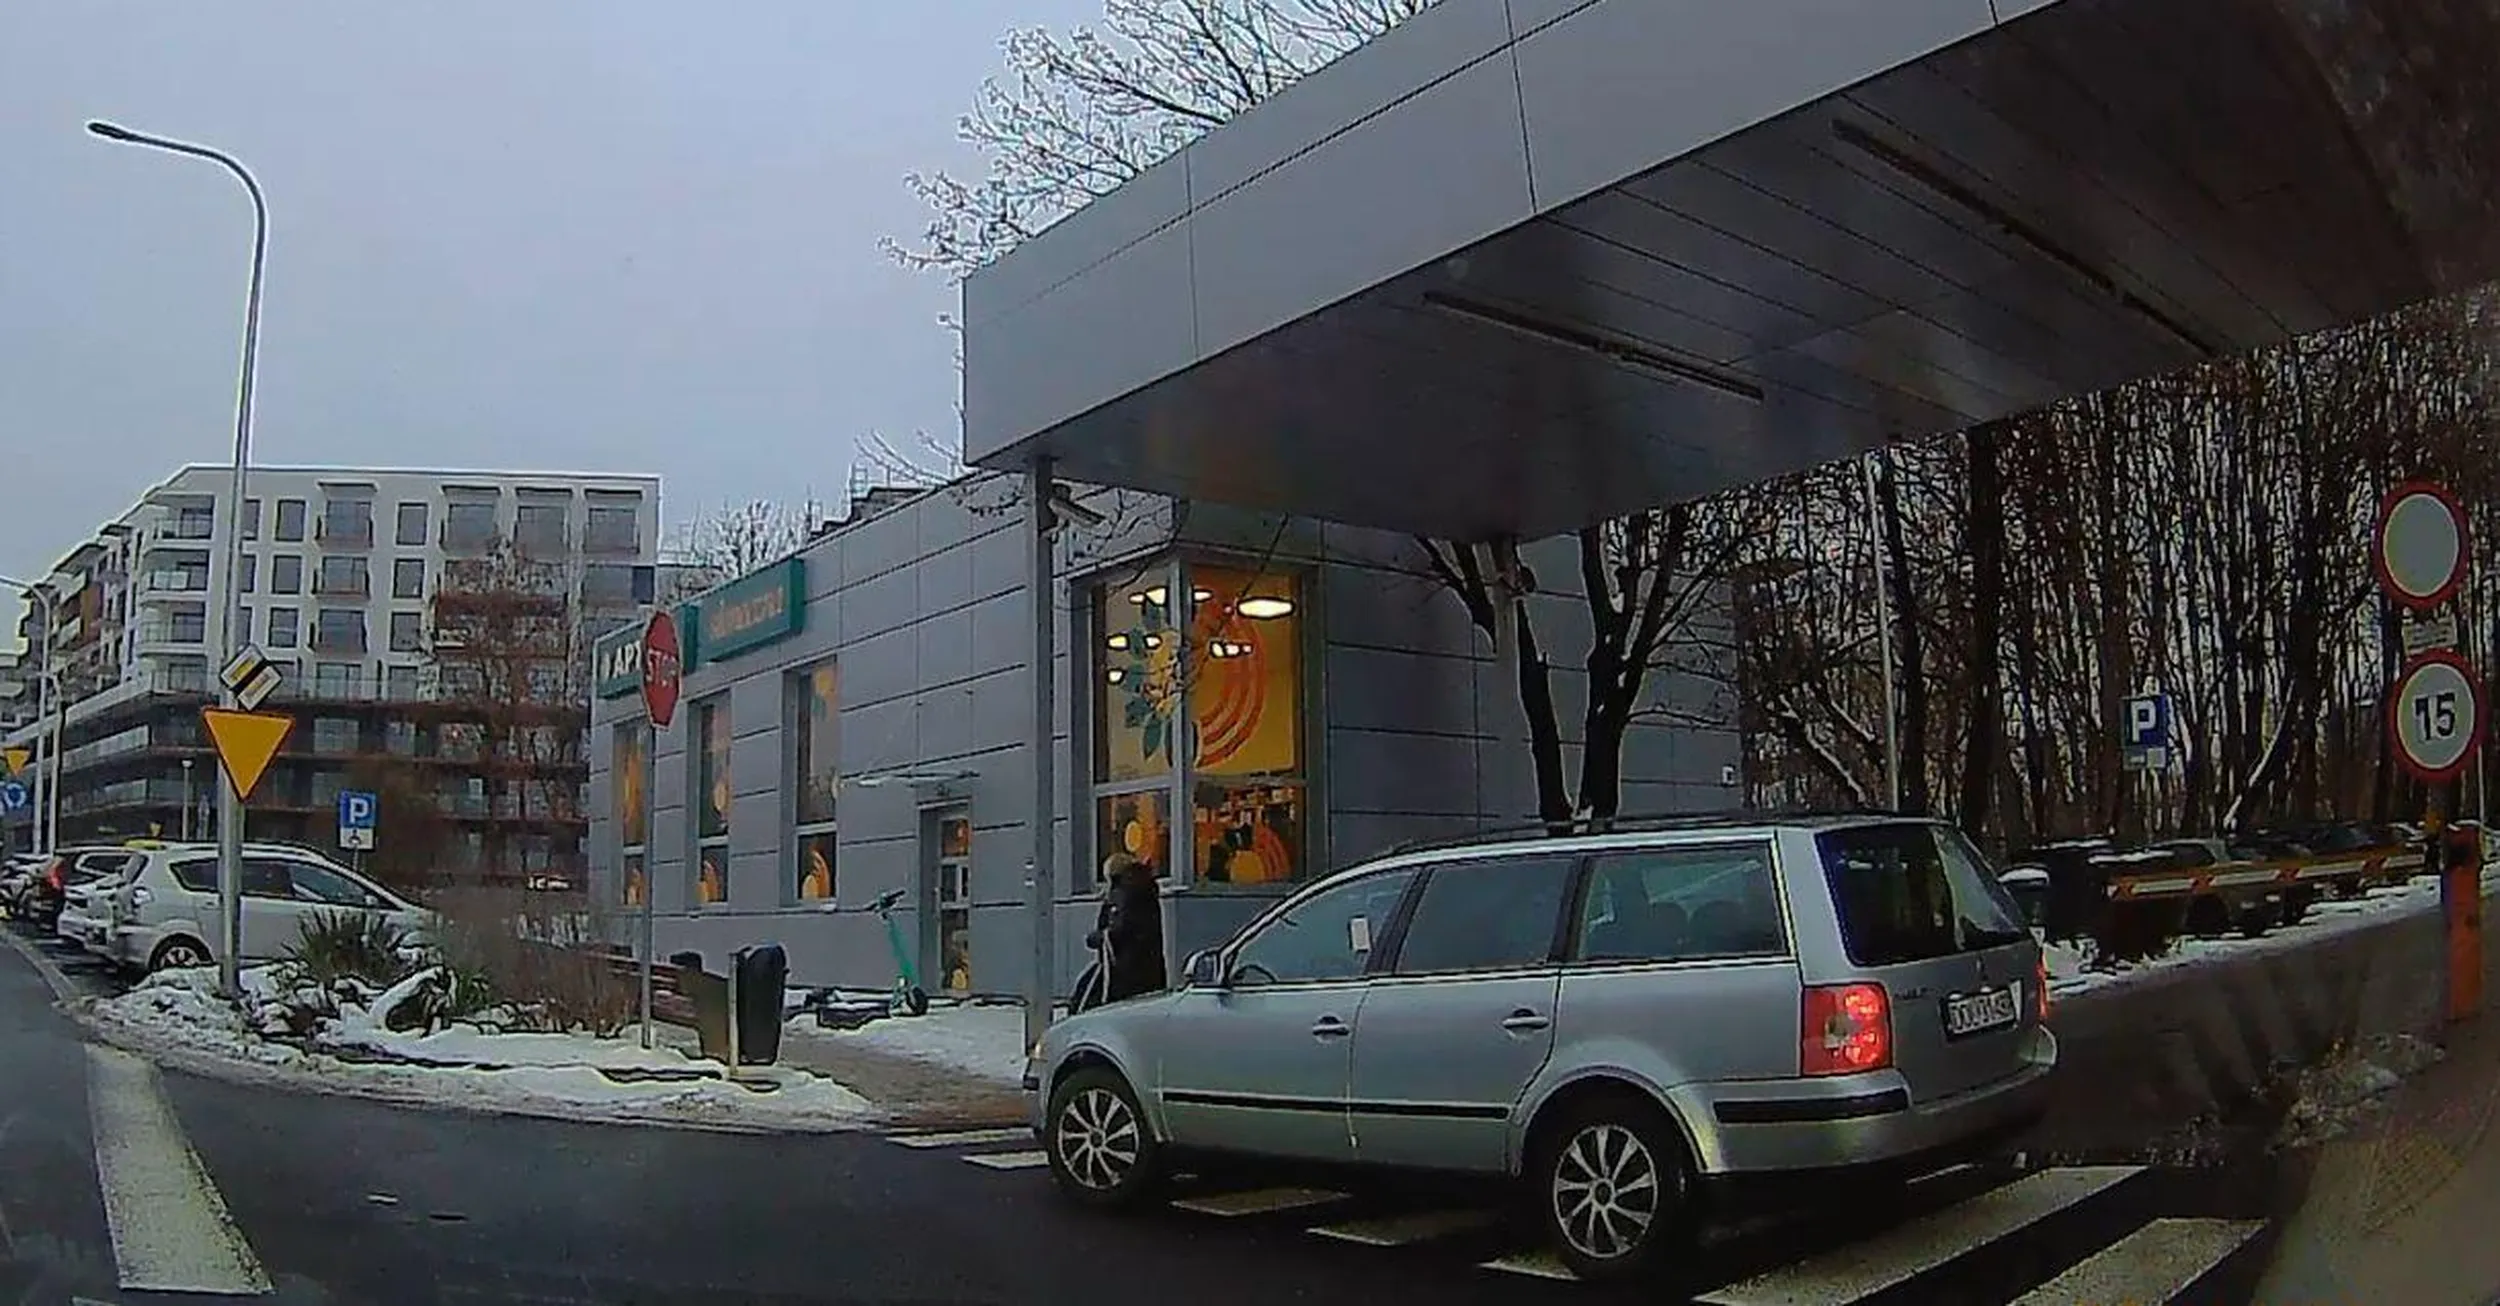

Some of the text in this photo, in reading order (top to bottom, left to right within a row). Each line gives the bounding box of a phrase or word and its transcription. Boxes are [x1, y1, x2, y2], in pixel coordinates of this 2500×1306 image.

[612, 639, 642, 679] APT
[646, 647, 679, 688] STOP
[2131, 700, 2157, 742] P
[2414, 692, 2456, 741] 15
[349, 798, 369, 824] P
